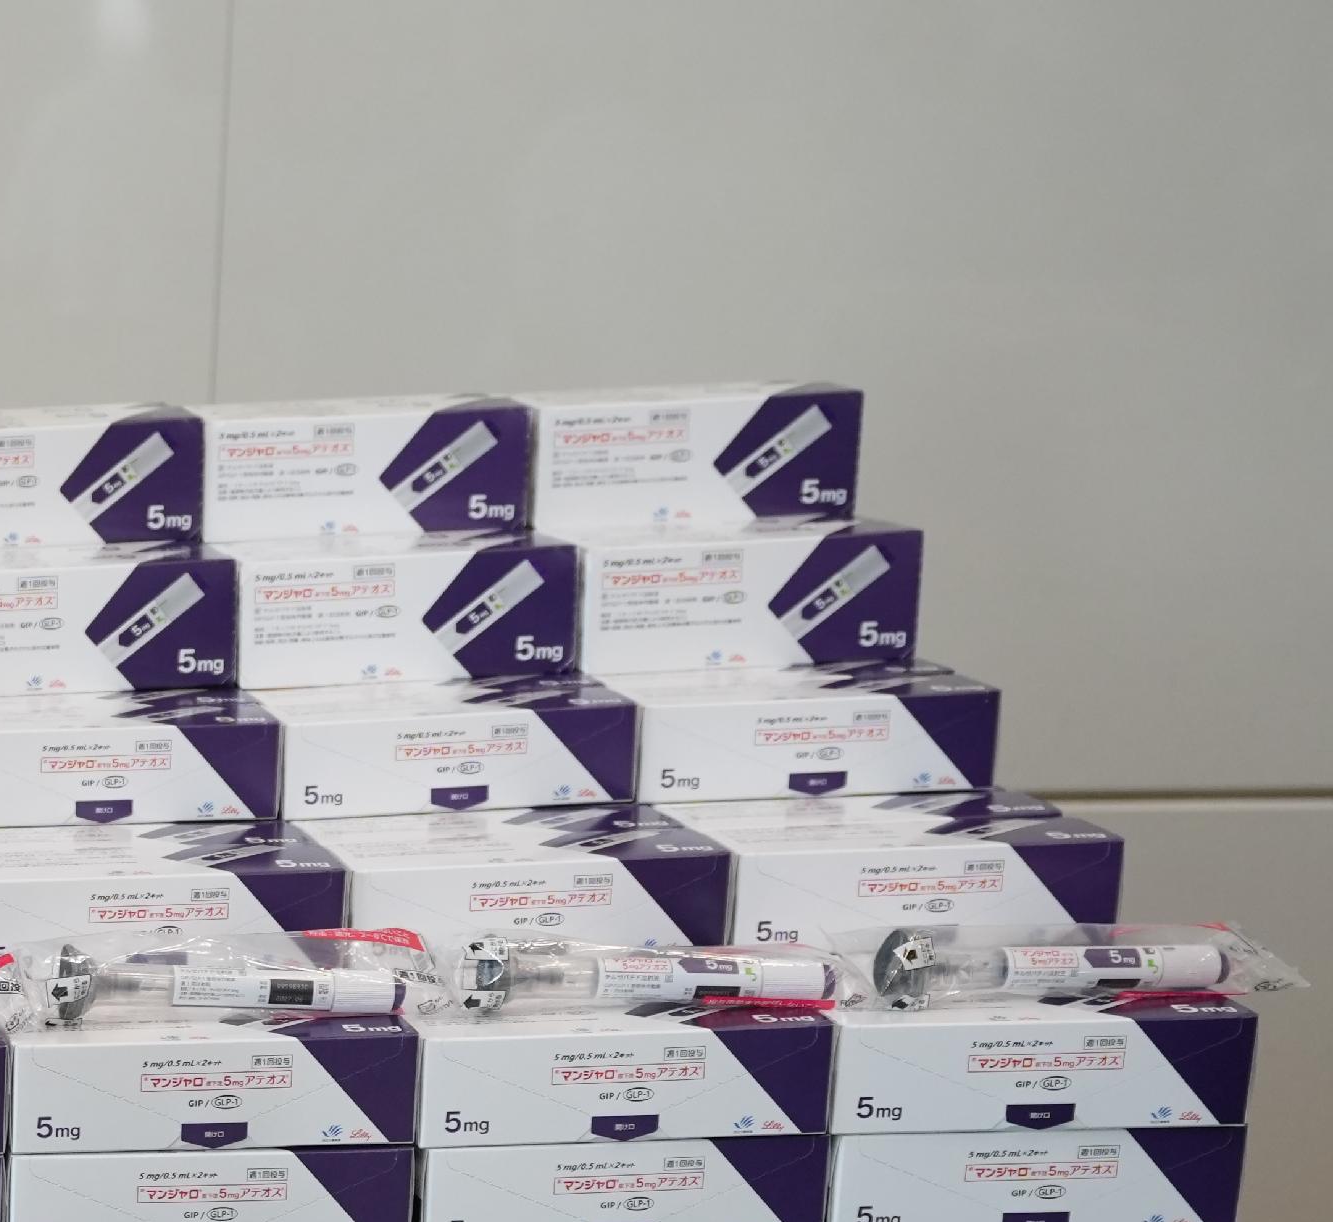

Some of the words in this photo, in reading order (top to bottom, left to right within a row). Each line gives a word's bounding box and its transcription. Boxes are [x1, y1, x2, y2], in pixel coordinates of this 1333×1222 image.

[800, 479, 847, 505] 5mg
[147, 505, 192, 530] 5mg
[469, 494, 514, 520] 5mg
[859, 621, 906, 648] 5mg
[177, 649, 224, 675] 5mg
[516, 636, 563, 662] 5mg
